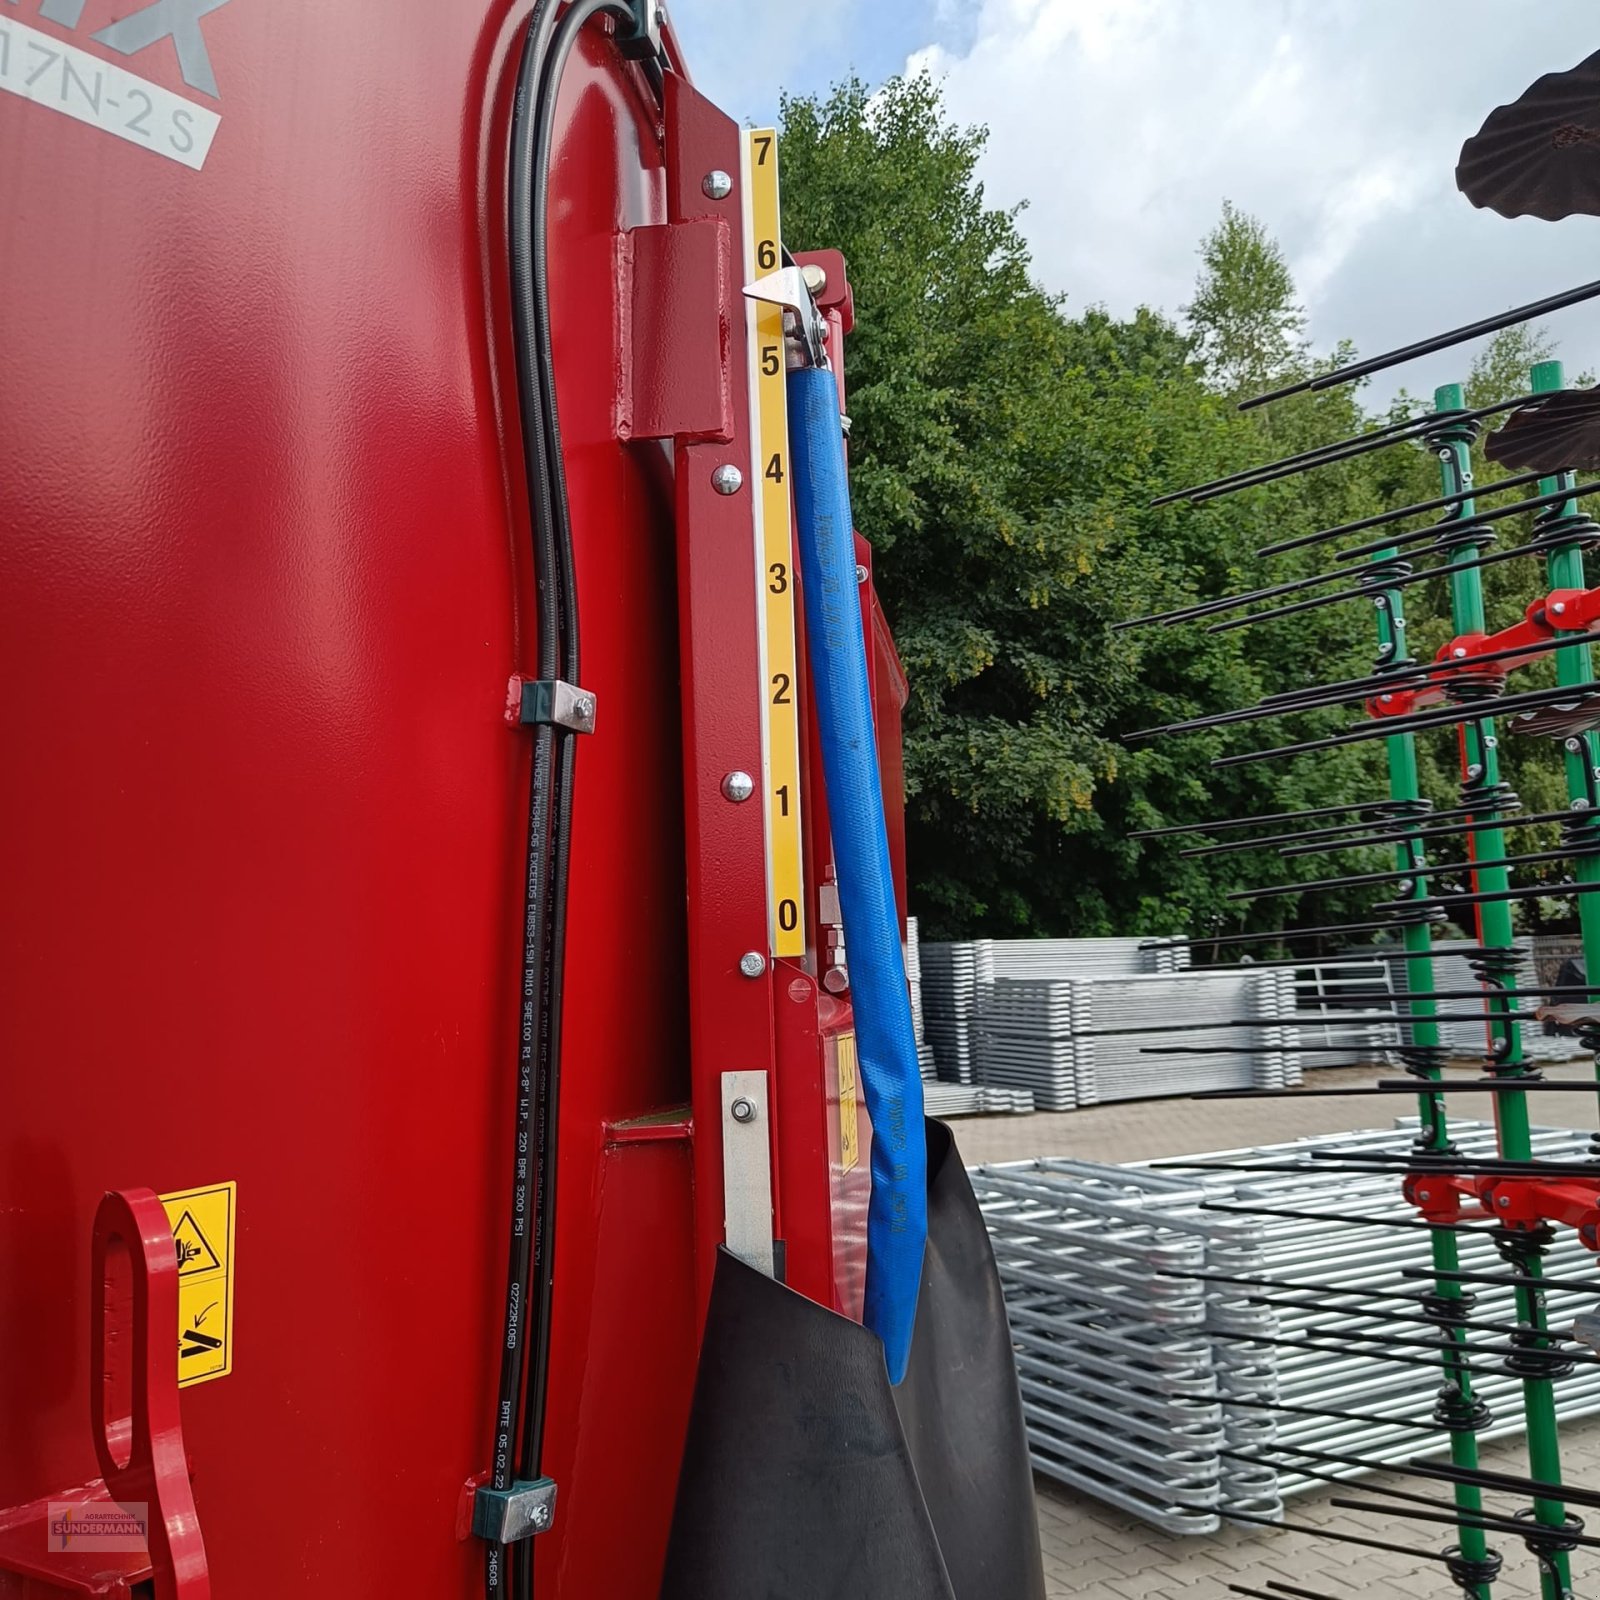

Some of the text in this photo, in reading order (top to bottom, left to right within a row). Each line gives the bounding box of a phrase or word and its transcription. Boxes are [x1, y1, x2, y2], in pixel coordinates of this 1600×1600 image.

[169, 109, 194, 153] S
[754, 136, 771, 166] 7
[757, 239, 776, 270] 6
[762, 345, 780, 376] 5
[765, 453, 784, 484] 4
[769, 563, 787, 594] 3
[772, 673, 791, 705] 2
[533, 739, 545, 790] POLYHOSE
[775, 785, 788, 817] 1
[528, 852, 539, 899] EXCEEDS
[778, 899, 798, 932] 0
[525, 904, 537, 964] EN853-1SN
[524, 968, 534, 996] DN10
[522, 1001, 533, 1041] SAE100
[521, 1046, 531, 1060] R1
[519, 1098, 529, 1124] W.P.
[518, 1132, 528, 1153] 220
[517, 1157, 527, 1179] BAR
[515, 1184, 525, 1212] 3200
[514, 1217, 523, 1236] PSI
[494, 1400, 511, 1490] DATE 05.02.22
